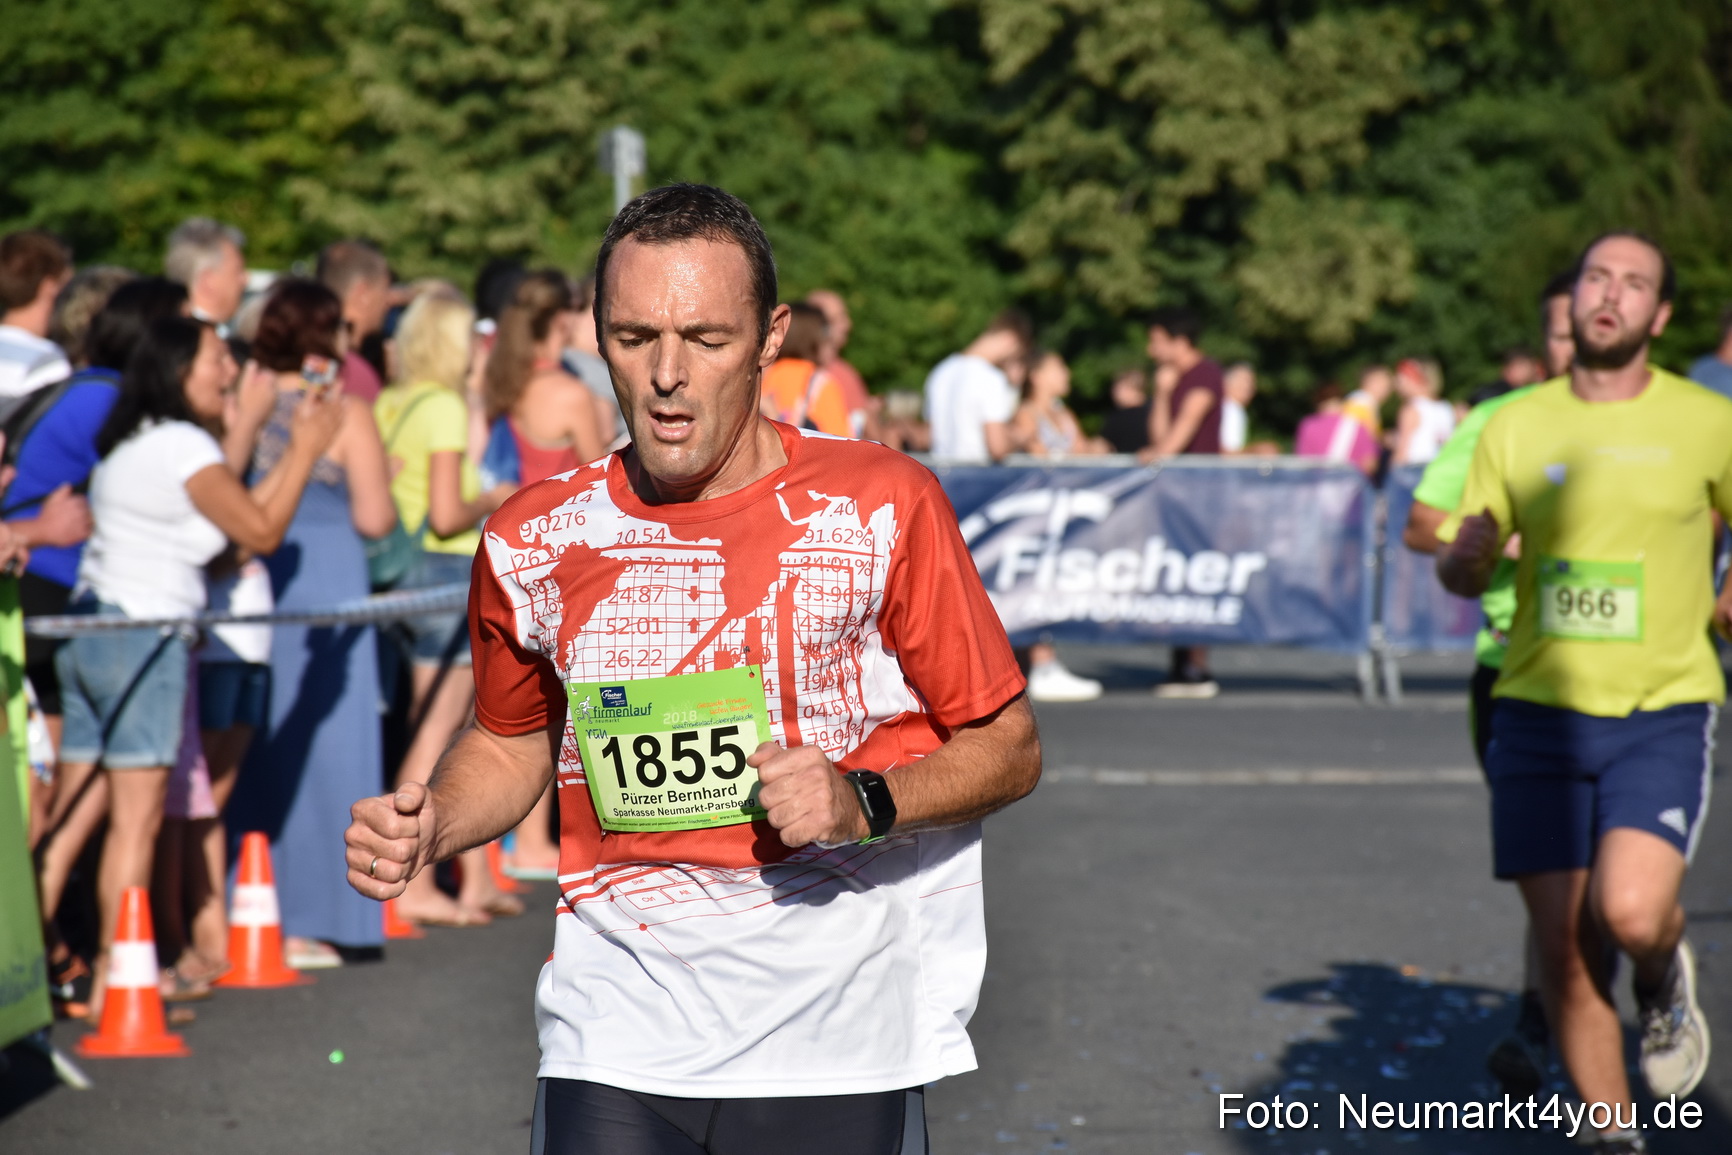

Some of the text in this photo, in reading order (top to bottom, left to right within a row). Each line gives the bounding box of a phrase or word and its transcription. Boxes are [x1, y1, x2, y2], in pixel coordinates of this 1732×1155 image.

[616, 527, 667, 546] 10.54
[803, 528, 872, 547] 91.62%
[995, 535, 1268, 595] Fischer
[1022, 594, 1243, 625] AUTOMOBILE
[1557, 587, 1617, 619] 966
[606, 617, 664, 635] 52.01
[604, 649, 662, 669] 26.22
[593, 702, 653, 718] firmenlauf
[663, 710, 698, 725] 2018
[602, 725, 747, 789] 1855
[621, 782, 738, 805] Pürzer Bernhard
[613, 798, 755, 818] Sparkasse Neumarkt-Parsberg
